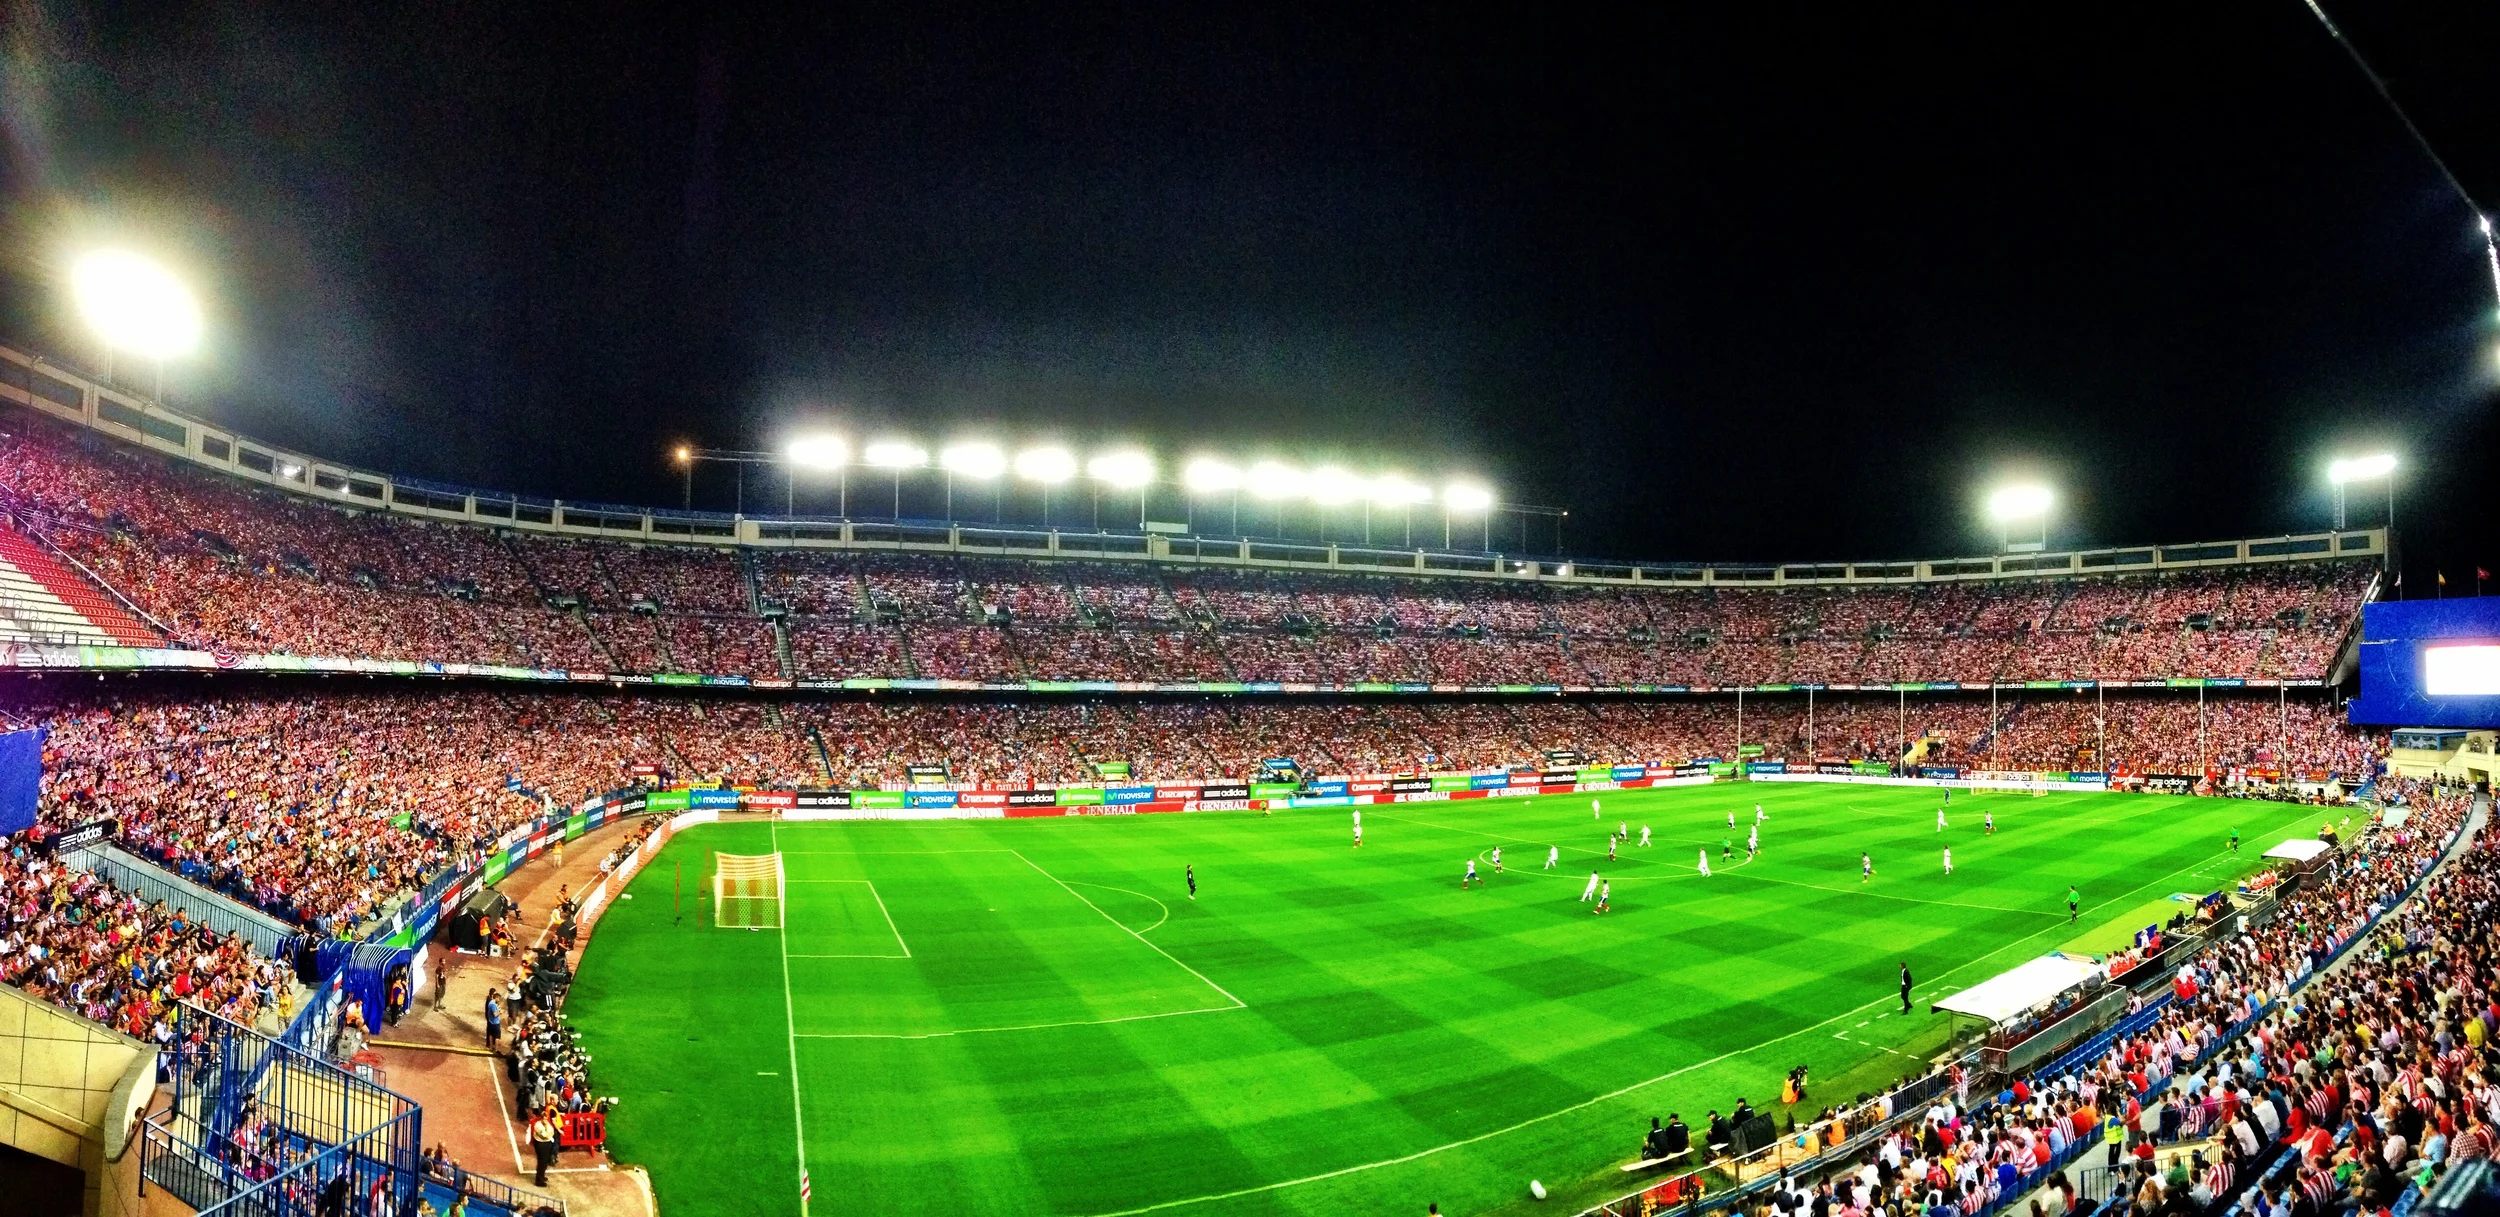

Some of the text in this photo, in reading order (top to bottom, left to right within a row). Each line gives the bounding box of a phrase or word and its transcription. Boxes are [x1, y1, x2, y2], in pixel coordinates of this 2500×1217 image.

[43, 648, 80, 667] adidas
[570, 671, 606, 682] Cruzcampo
[626, 674, 653, 683] adidas
[712, 677, 747, 687] movistar
[753, 678, 792, 689] Cruzcampo
[814, 680, 842, 689] adidas
[1001, 681, 1027, 691] adidas
[2070, 681, 2096, 689] movistar
[2215, 679, 2243, 687] movistar
[2246, 680, 2279, 688] Cruzcampo
[1935, 683, 1958, 691] movistar
[1407, 781, 1432, 790] adidas
[1479, 778, 1508, 787] movistar
[2163, 778, 2188, 787] adidas
[1117, 791, 1152, 800] movistar
[1220, 788, 1248, 797] adidas
[747, 794, 793, 806] Cruzcampo
[817, 796, 850, 805] adidas
[919, 794, 956, 804] movistar
[961, 793, 1007, 804] Cruzcampo
[1025, 794, 1055, 803] adidas
[628, 799, 647, 810] adidas
[1199, 800, 1248, 811] GENERALI
[77, 825, 103, 843] adidas
